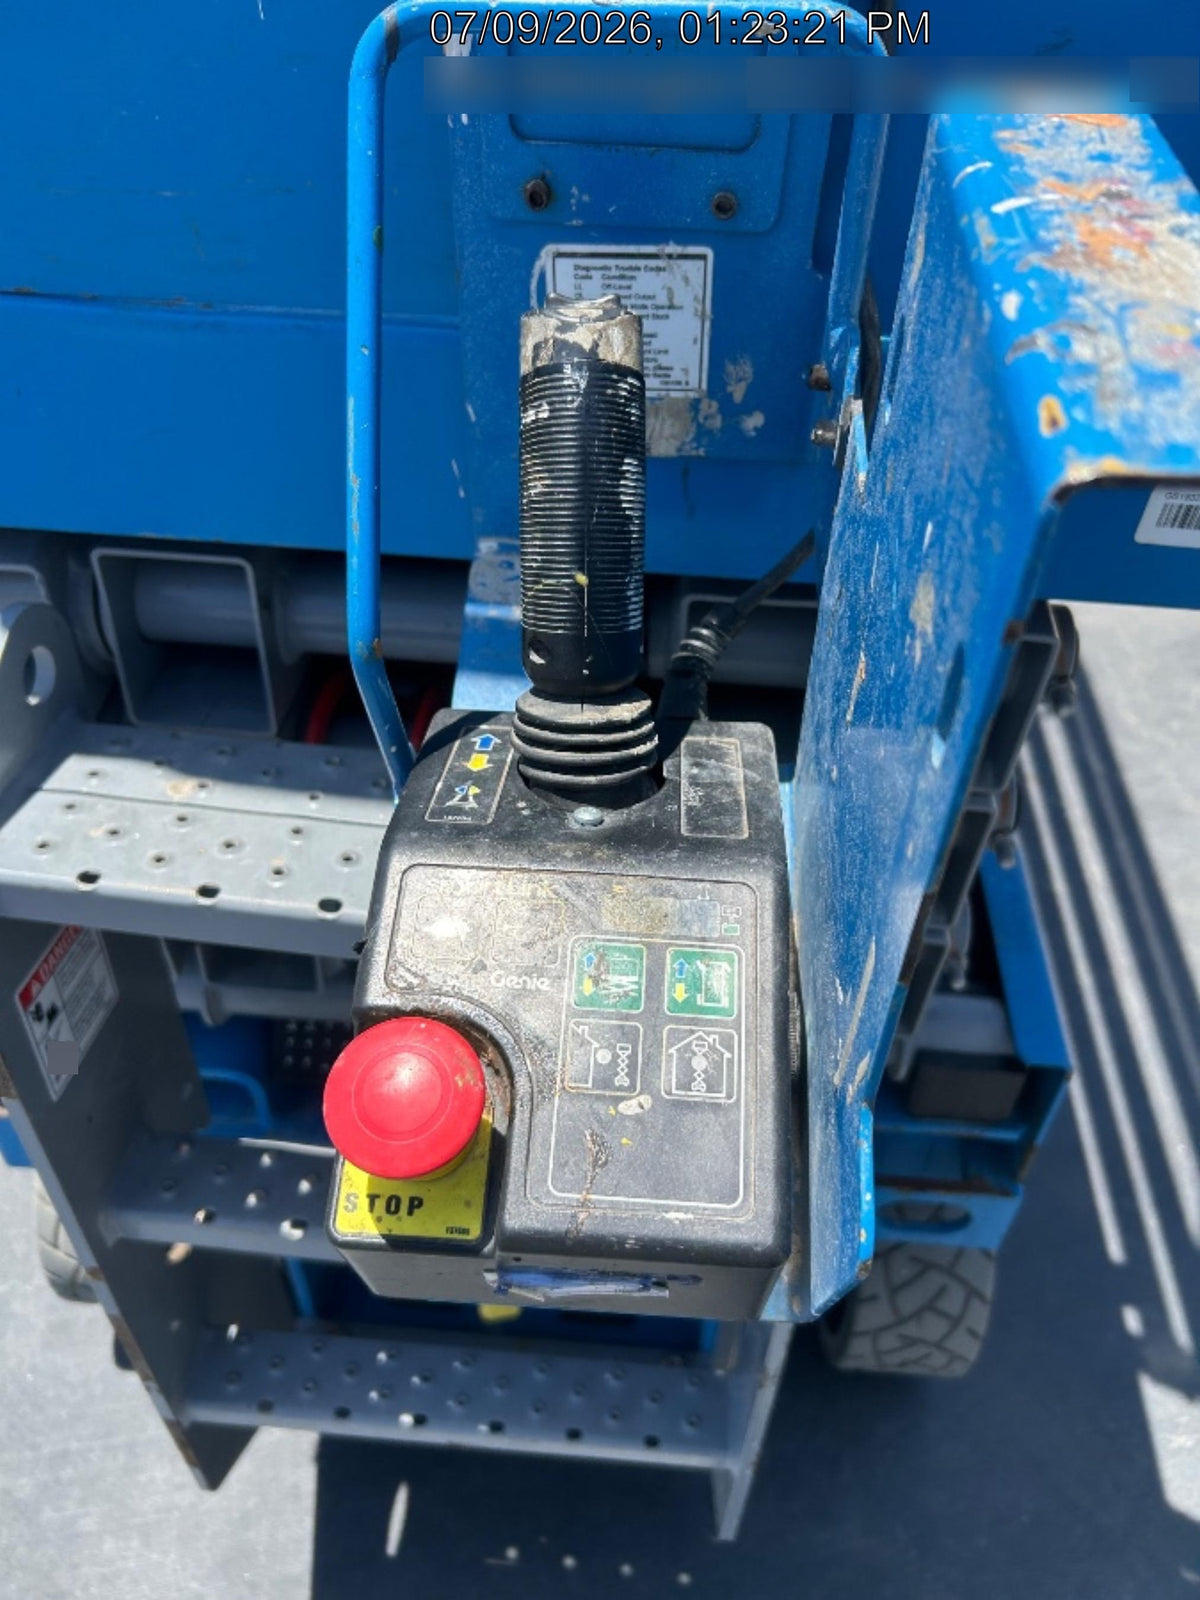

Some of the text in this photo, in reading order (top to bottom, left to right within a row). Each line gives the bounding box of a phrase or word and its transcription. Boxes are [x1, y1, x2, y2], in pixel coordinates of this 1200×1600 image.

[573, 264, 612, 273] Diagnostic
[614, 264, 641, 272] Trouble
[490, 968, 551, 991] Genie
[343, 1192, 425, 1217] STOP
